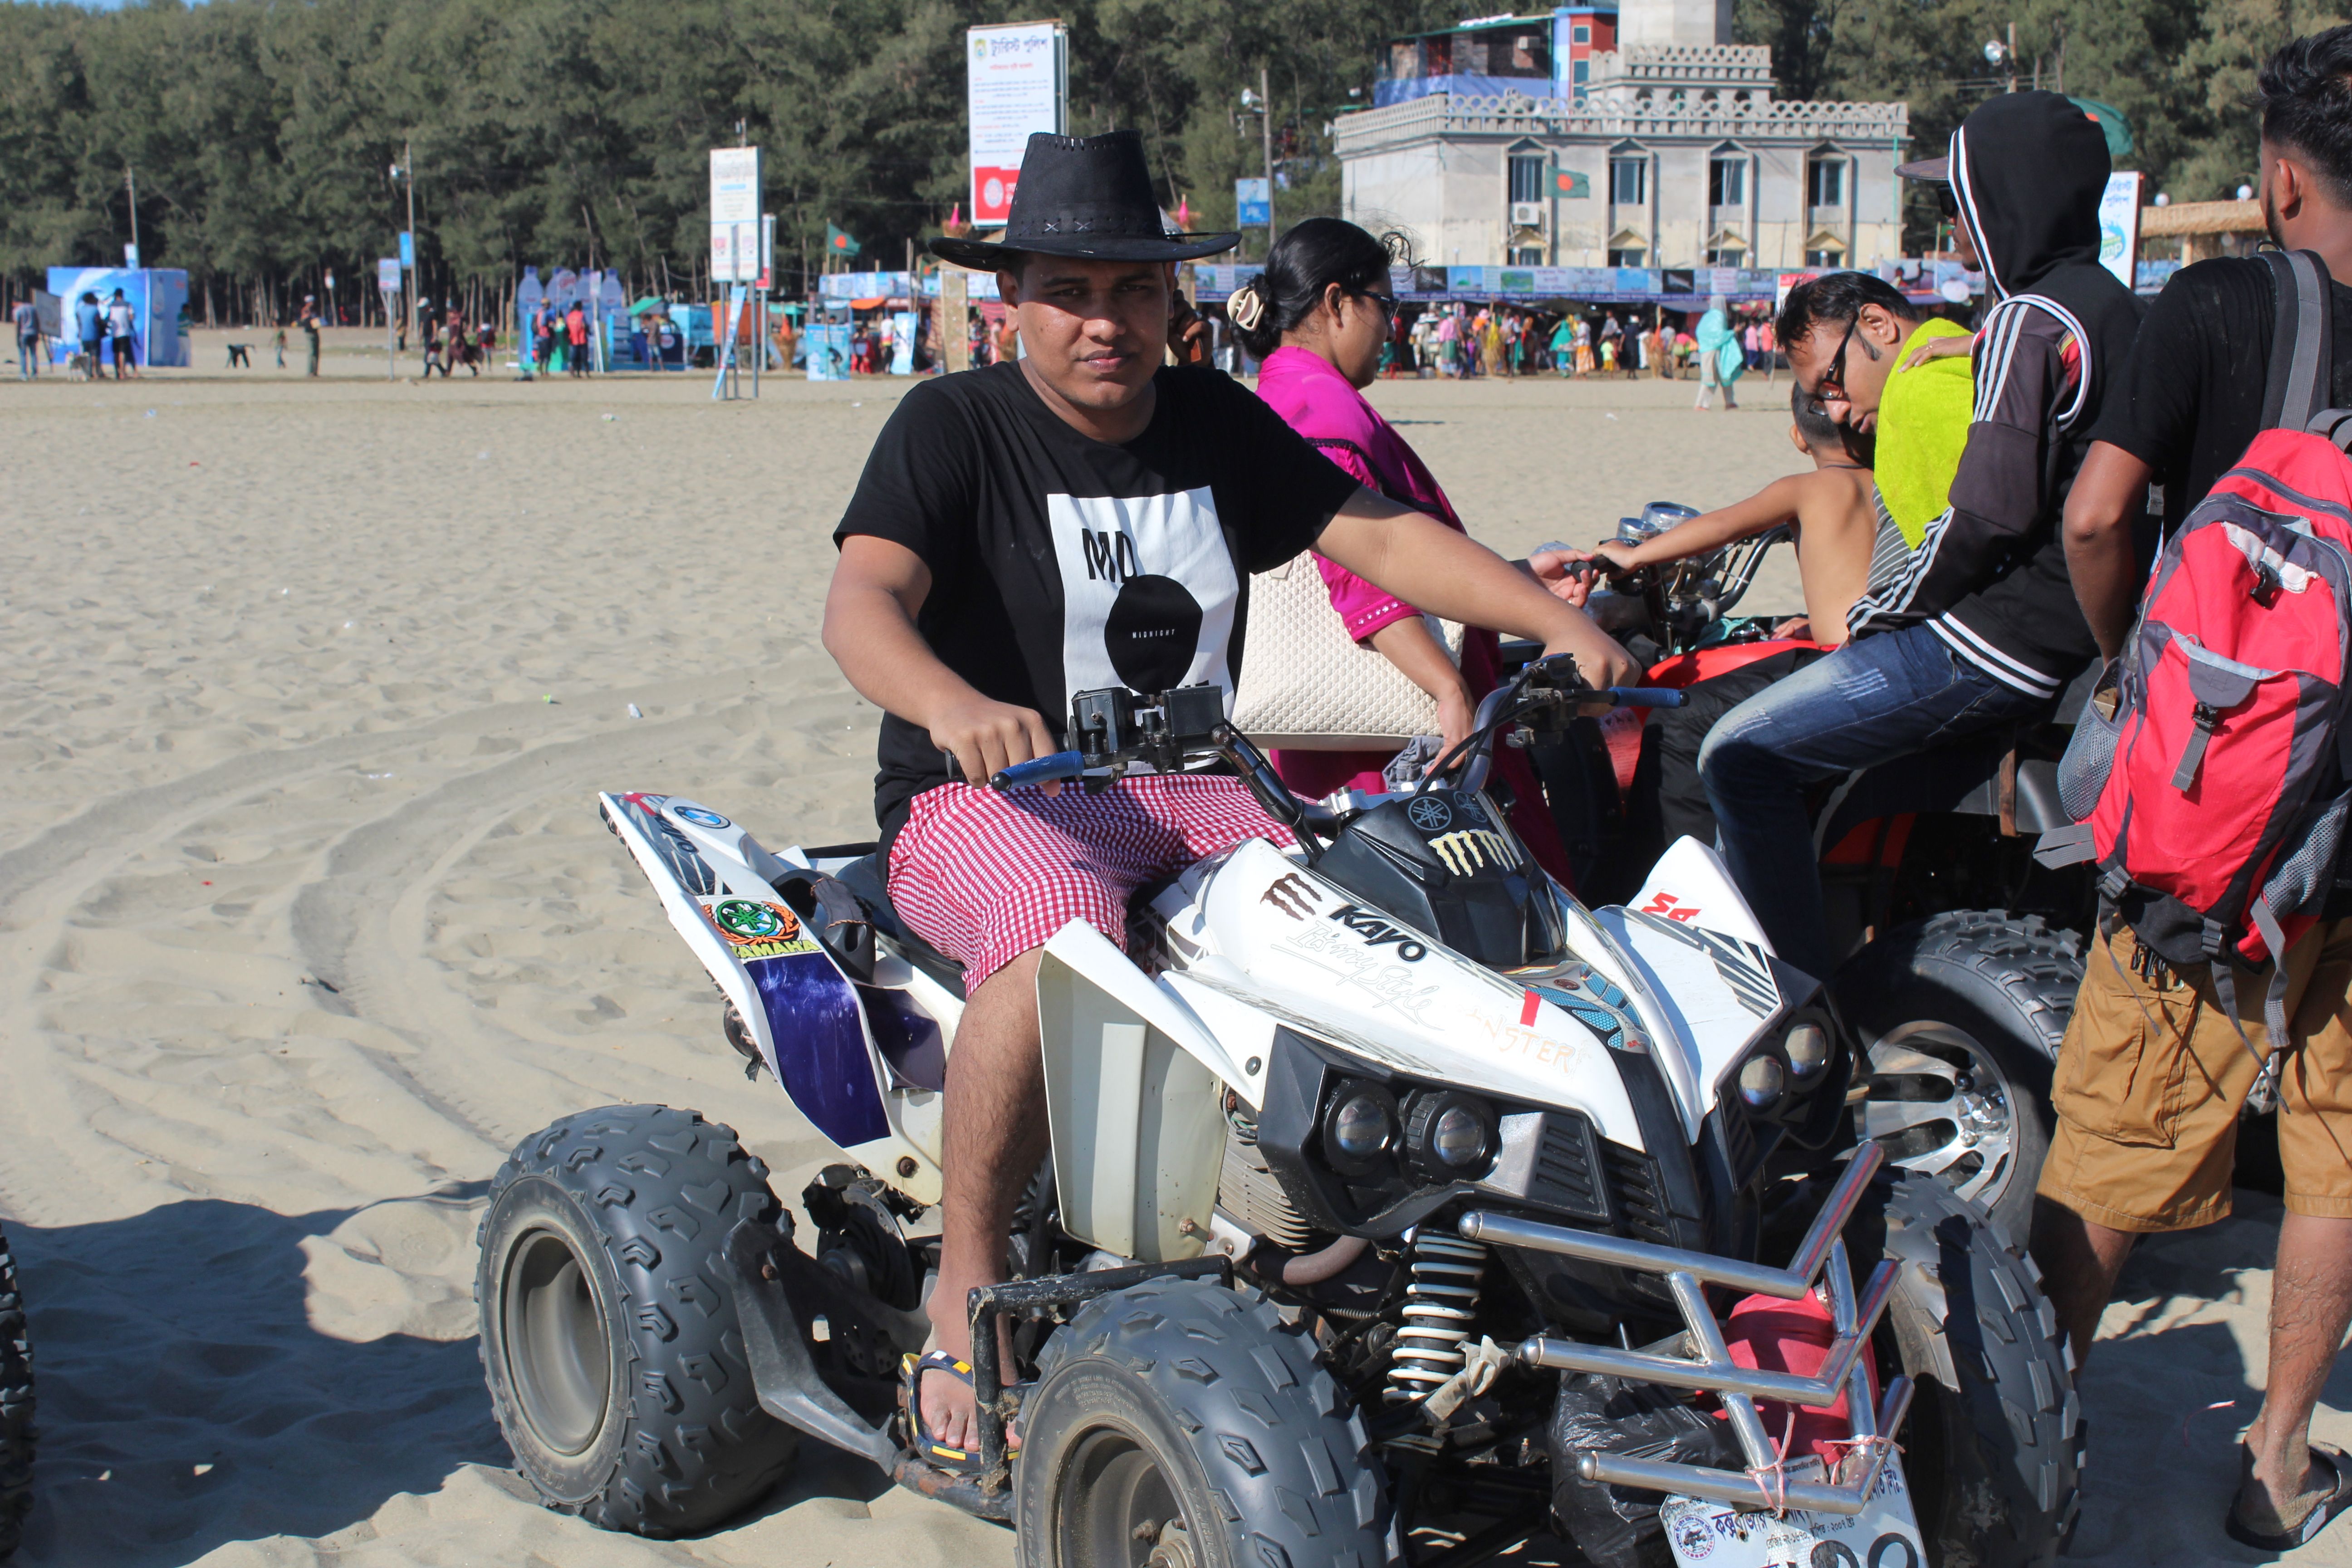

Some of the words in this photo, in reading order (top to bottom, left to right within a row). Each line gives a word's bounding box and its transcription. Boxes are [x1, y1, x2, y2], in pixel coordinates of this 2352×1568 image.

[1132, 629, 1175, 639] MIDNIGHT
[1328, 904, 1427, 963] KAYO
[730, 939, 822, 959] YAMAHA
